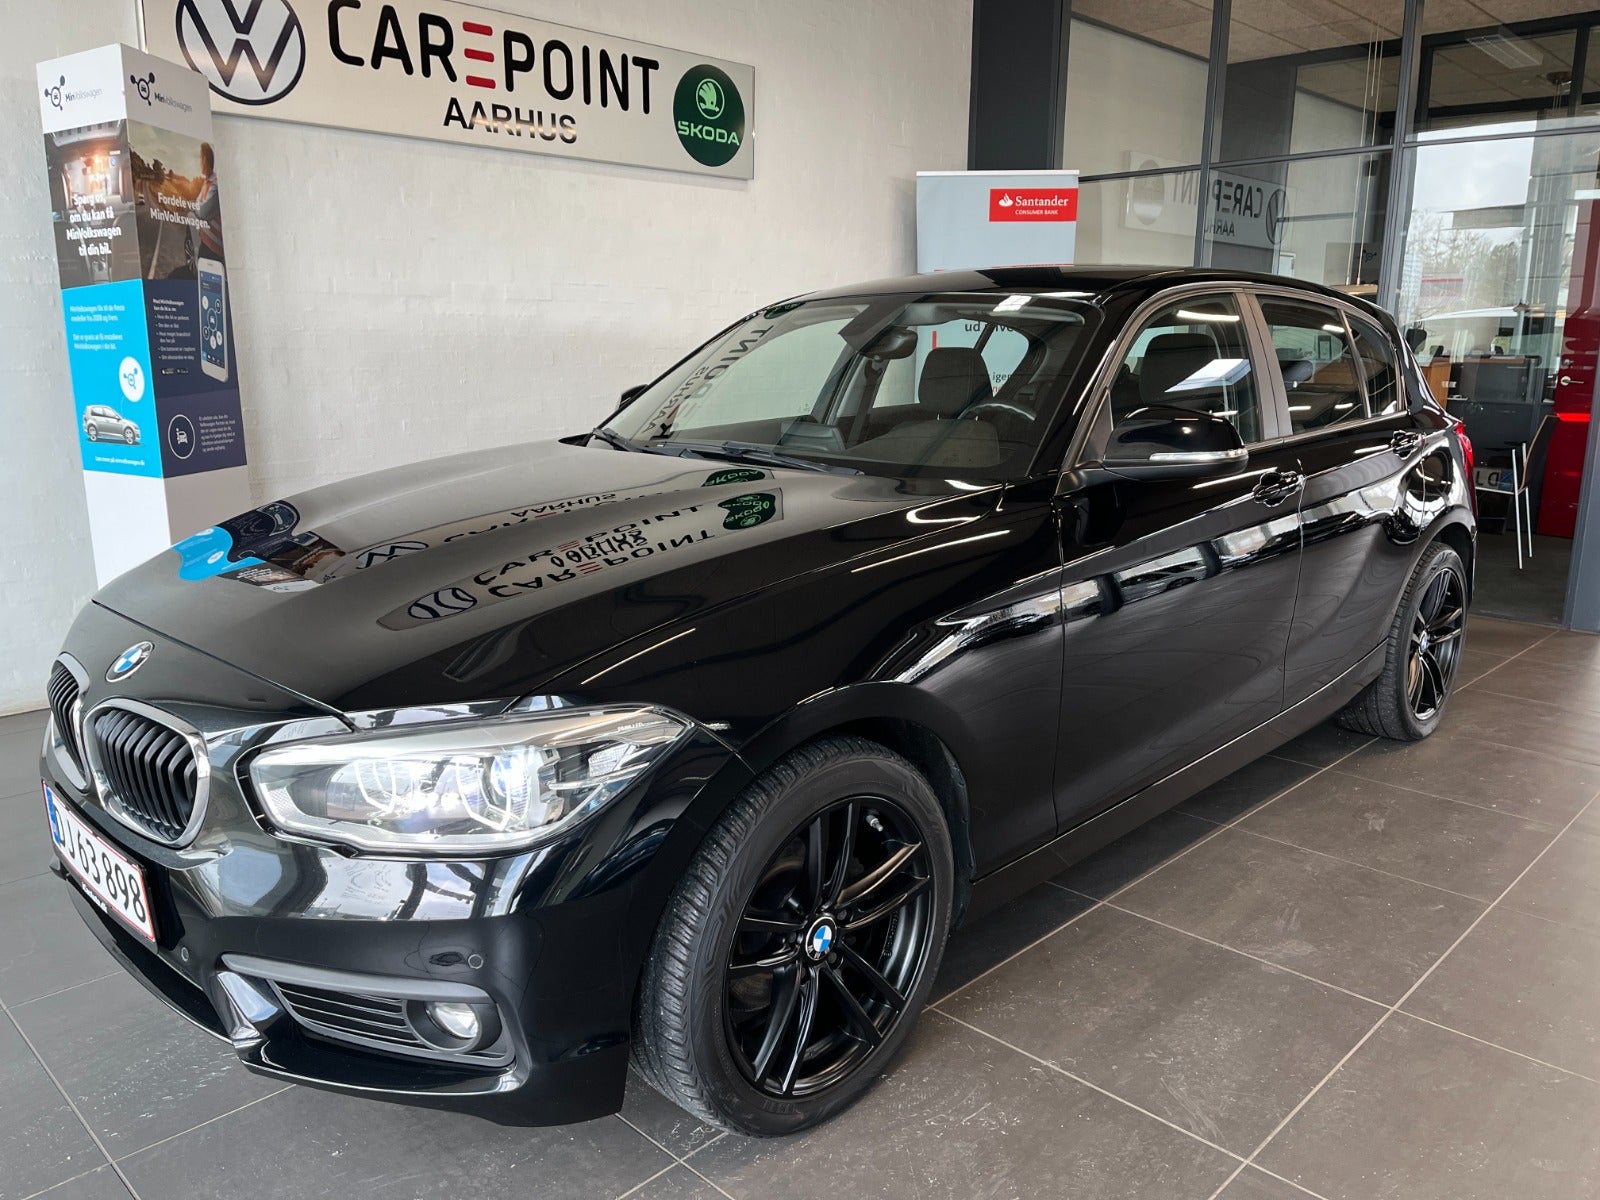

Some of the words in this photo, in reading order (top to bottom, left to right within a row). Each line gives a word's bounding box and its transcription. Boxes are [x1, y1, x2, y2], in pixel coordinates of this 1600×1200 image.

[443, 97, 578, 144] AARHUS
[157, 192, 187, 209] Fordele
[187, 198, 201, 211] ved
[1015, 195, 1069, 207] Santander
[69, 214, 81, 223] om
[92, 209, 105, 221] kan
[150, 208, 211, 229] MinVolkswagen.
[66, 226, 122, 240] MinVolkswagen
